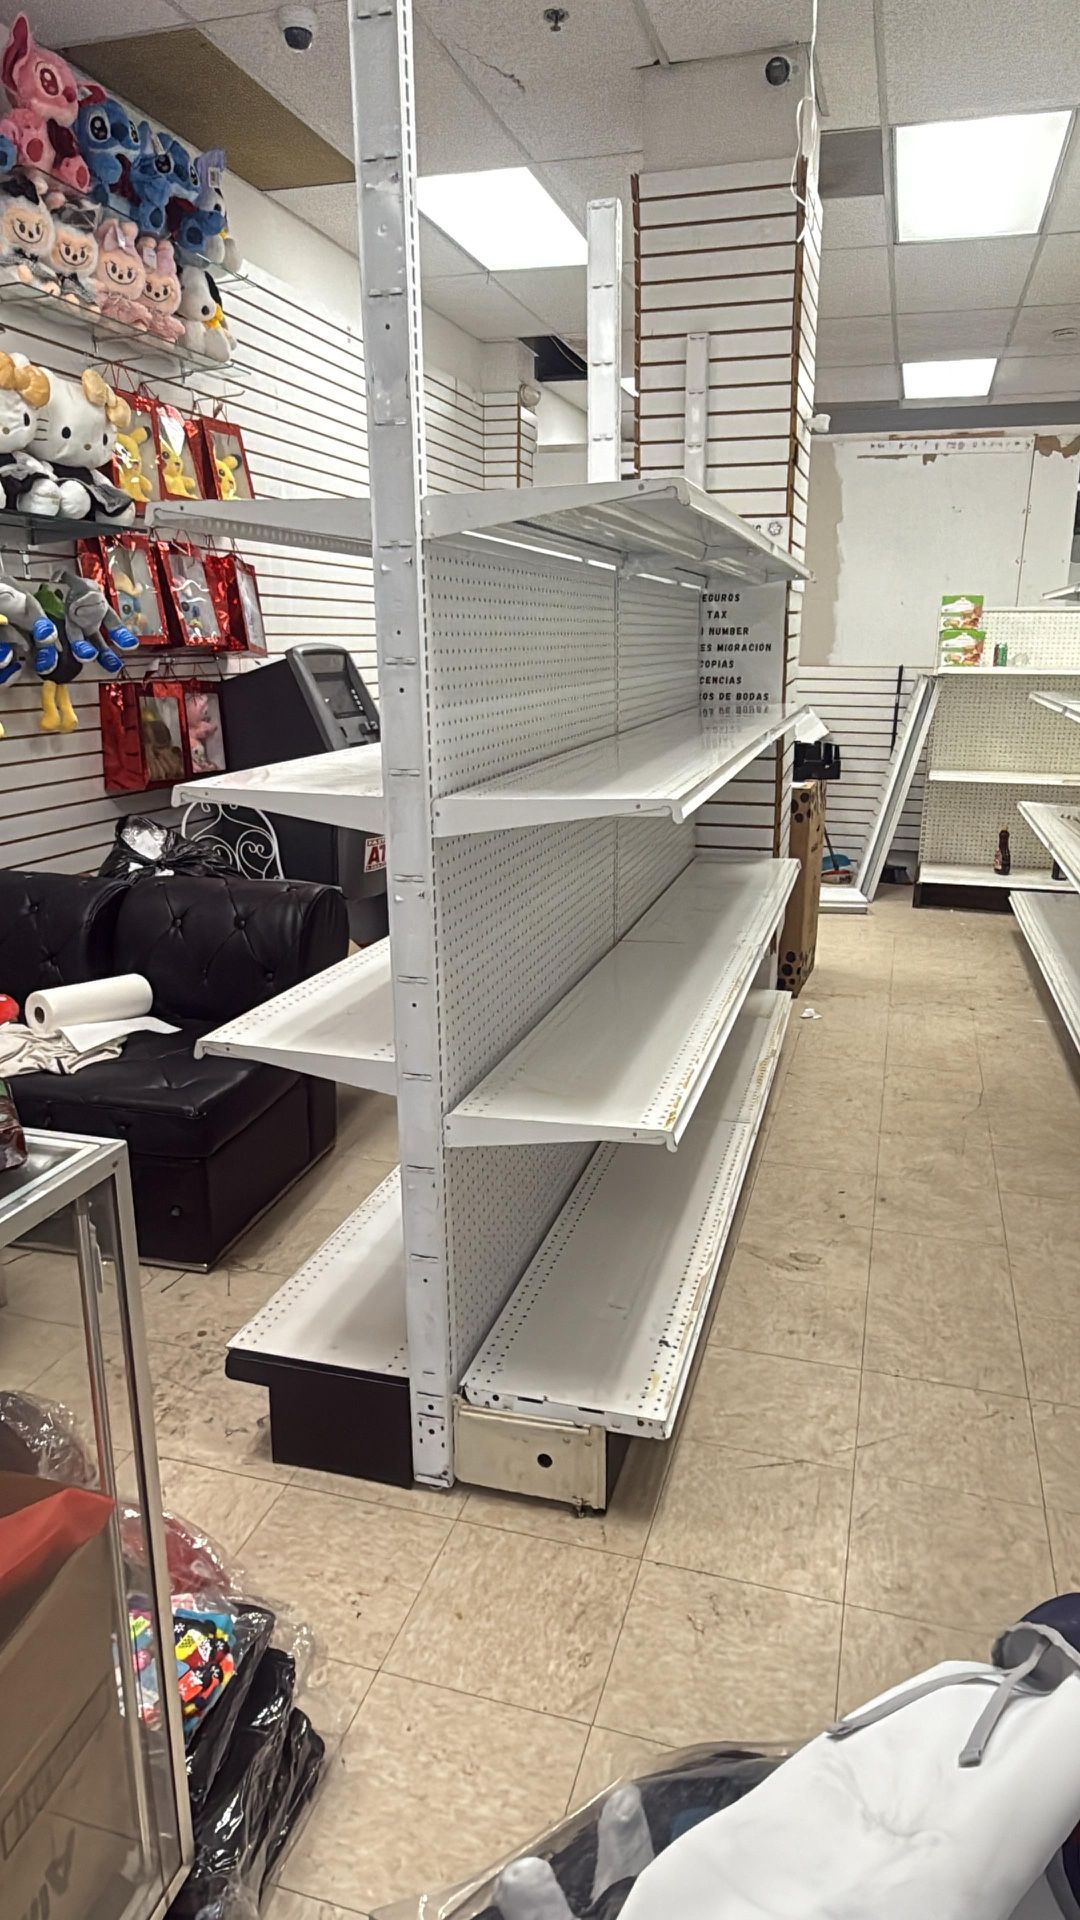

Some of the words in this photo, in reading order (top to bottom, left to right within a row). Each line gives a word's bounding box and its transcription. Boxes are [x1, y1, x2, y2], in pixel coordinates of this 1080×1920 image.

[707, 610, 727, 619] TAX
[709, 627, 749, 636] NUMBER
[717, 643, 772, 652] MIGRACION
[699, 692, 714, 701] OS
[719, 692, 731, 701] DE
[736, 692, 769, 701] BODAS
